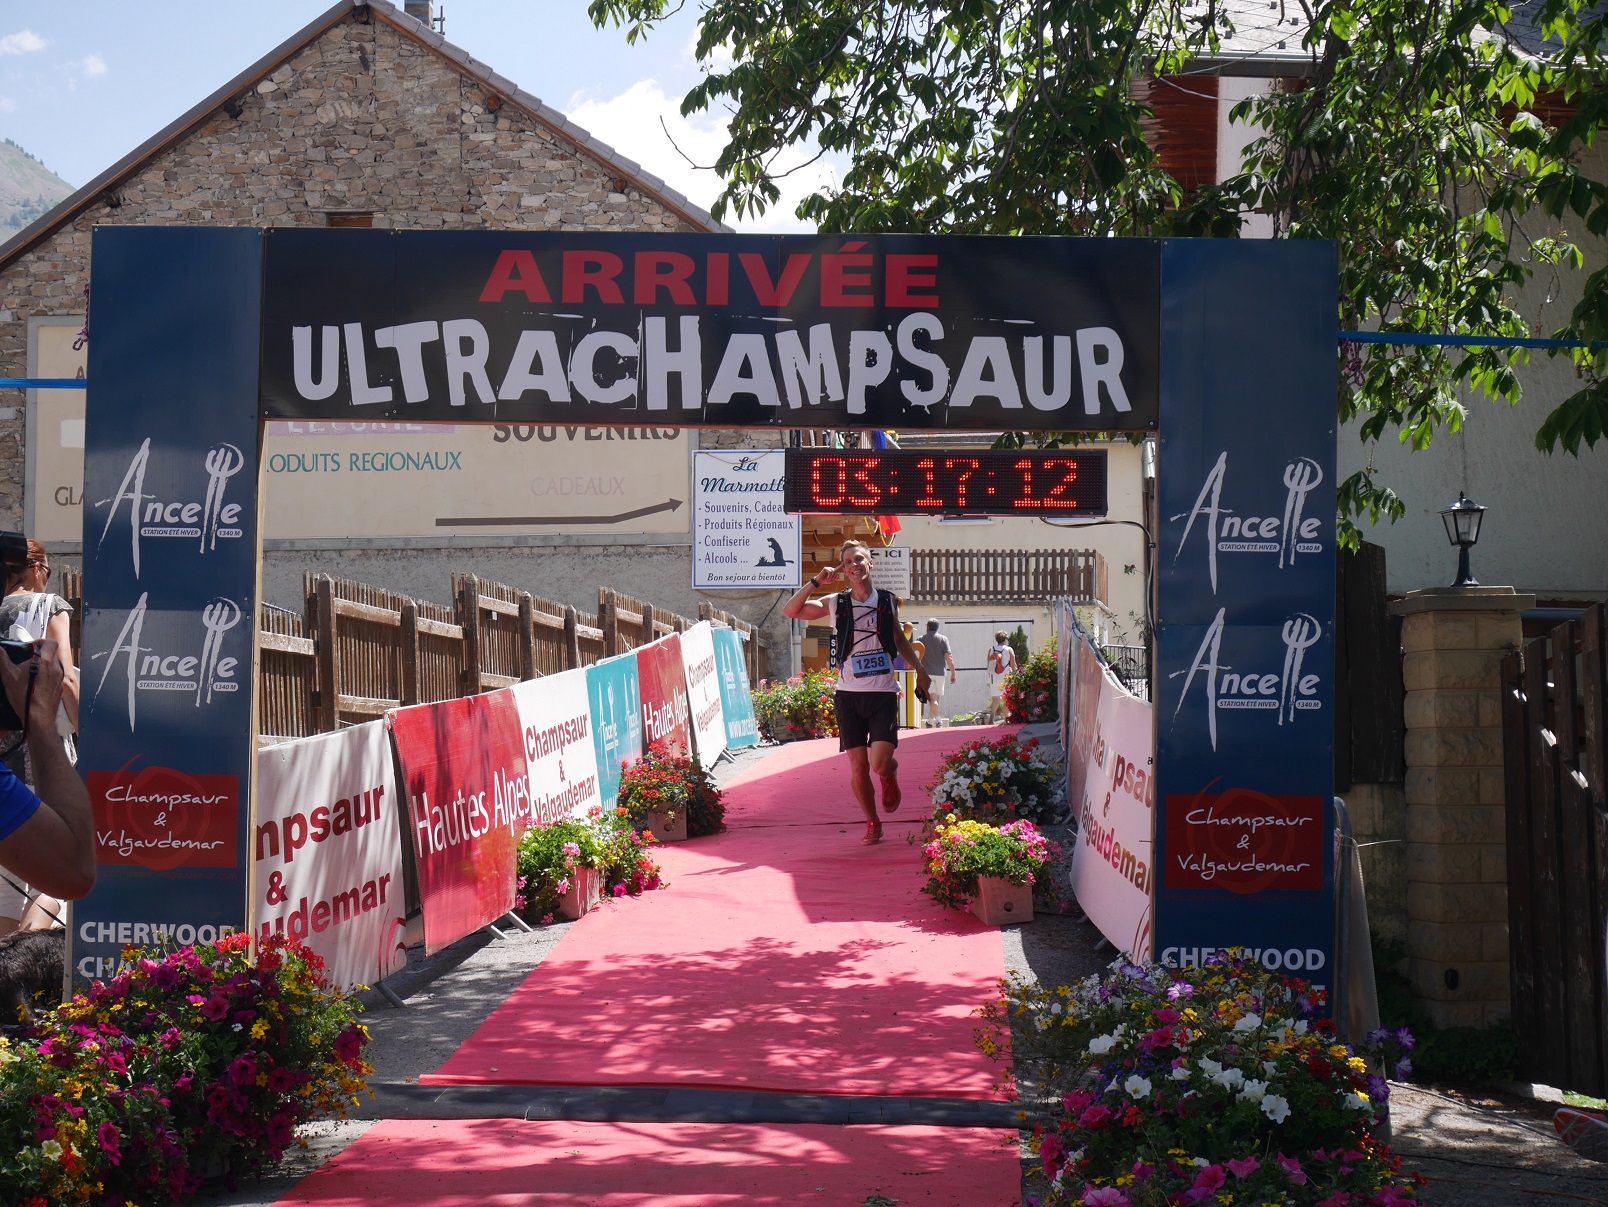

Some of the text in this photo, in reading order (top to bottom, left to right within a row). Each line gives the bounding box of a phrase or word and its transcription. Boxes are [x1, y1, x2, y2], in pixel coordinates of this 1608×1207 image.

[478, 241, 940, 308] ARRIVÉE
[292, 311, 1132, 415] ULTRACHAMPSAUR
[266, 452, 462, 473] ODUITS REGIONAUX
[732, 456, 759, 472] La
[531, 476, 626, 497] CADEAUX
[95, 437, 245, 580] Ancelle
[704, 500, 785, 514] Souvenirs, Cadea
[142, 528, 168, 536] STATION
[168, 528, 180, 536] ÉTÉ
[704, 518, 794, 532] Produits Régionaux
[1170, 451, 1324, 596] Ancelle
[704, 535, 751, 547] Confiserie
[1220, 543, 1246, 551] STATION
[1246, 542, 1258, 551] ÉTÉ
[704, 552, 738, 564] Alcools
[885, 549, 902, 558] ICI
[707, 573, 724, 581] Bon
[758, 572, 786, 582] bientôt
[91, 591, 241, 733] Ancelle
[856, 656, 886, 670] 1258
[139, 681, 165, 689] STATION
[165, 681, 176, 689] ÉTÉ
[1169, 607, 1322, 752] Ancelle
[1245, 699, 1257, 707] ÉTÉ
[643, 700, 676, 744] Hautes
[525, 713, 588, 762] Champsaur
[559, 759, 566, 782] &
[105, 784, 229, 811] Champsaur
[534, 774, 596, 822] Valgaudemar
[153, 812, 167, 826] &
[412, 767, 531, 858] Hautes Alpes
[1185, 806, 1314, 833] Champsaur
[96, 829, 225, 857] Valgaudemar
[1236, 834, 1250, 849] &
[1177, 852, 1311, 881] Valgaudemar
[266, 870, 288, 906] &
[256, 872, 391, 945] udemar
[1161, 946, 1326, 971] CHEWOOD
